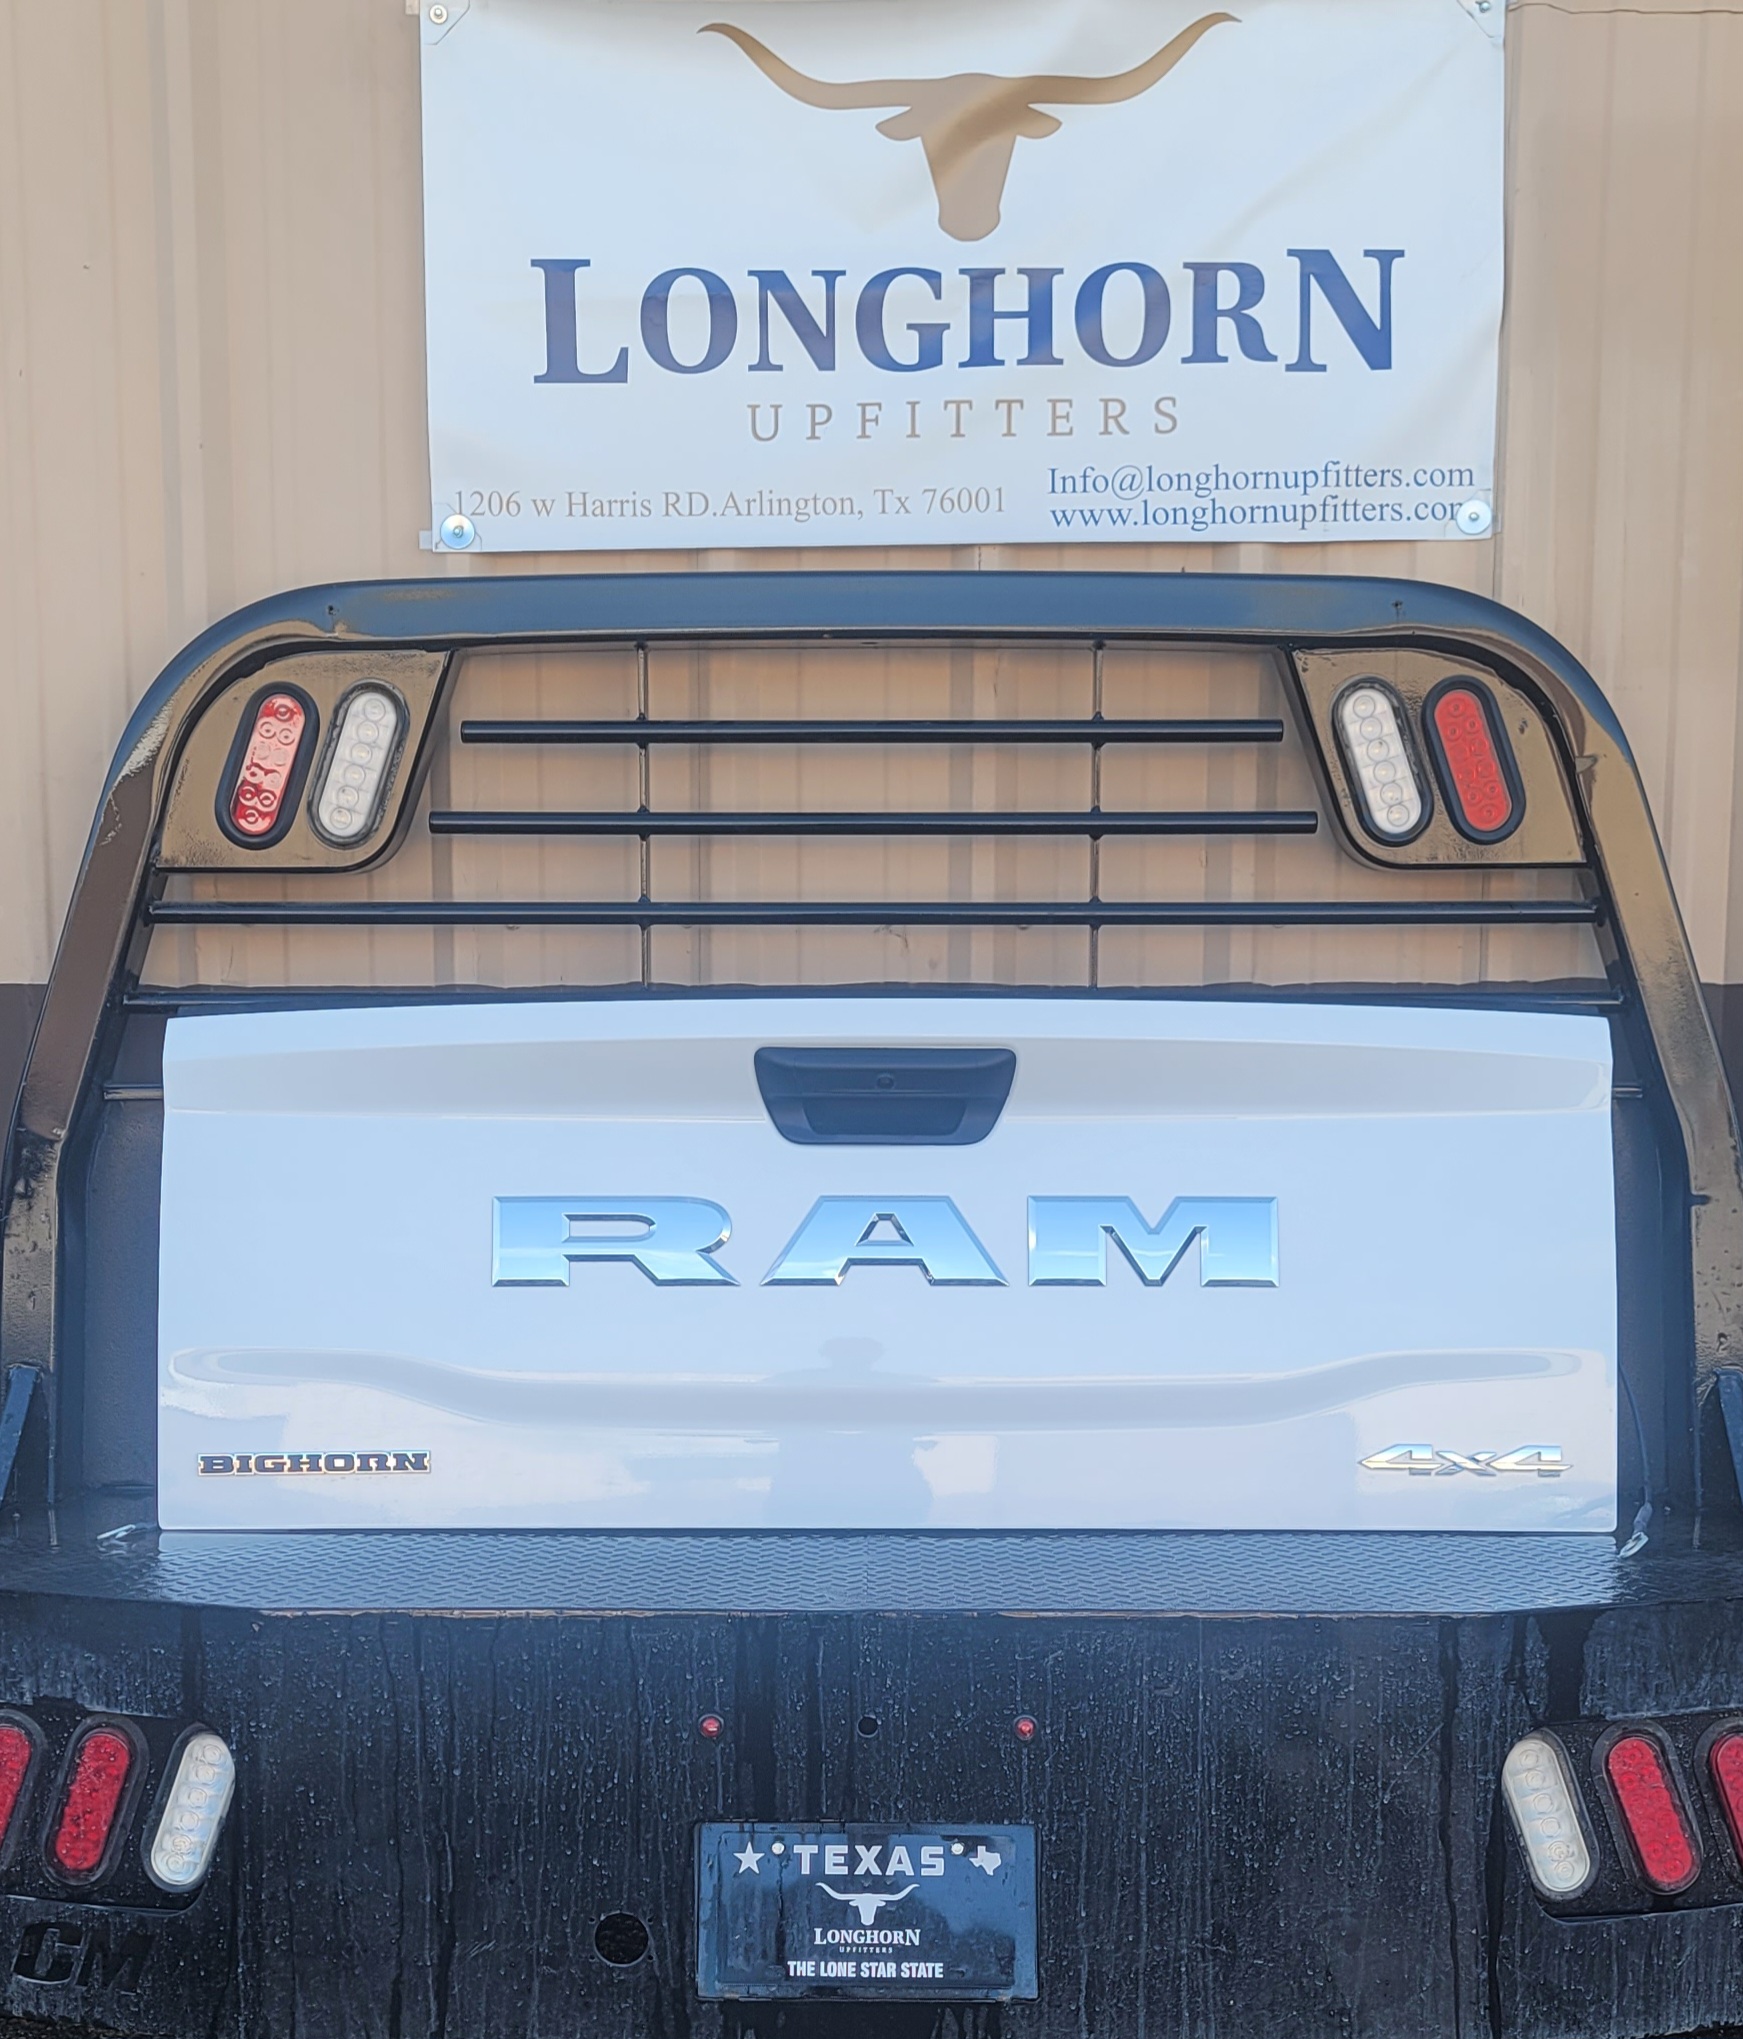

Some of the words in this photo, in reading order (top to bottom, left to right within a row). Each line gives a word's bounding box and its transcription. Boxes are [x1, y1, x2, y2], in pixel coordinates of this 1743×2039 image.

[531, 248, 1405, 385] LONGHORN
[746, 396, 1182, 443] UPFITTERS
[1047, 459, 1475, 501] Info@longhornupfitters.com
[455, 490, 521, 518] 1206
[531, 498, 556, 518] w
[565, 490, 653, 519] Harris
[661, 487, 865, 523] RD.Arlington,
[873, 488, 912, 515] Tx
[921, 486, 1006, 516] 76001
[491, 1195, 1281, 1288] RAM
[198, 1450, 431, 1475] BIGHORN
[1358, 1443, 1574, 1478] 4x4
[794, 1845, 944, 1876] TEXAS
[813, 1928, 921, 1946] LONGHORN
[787, 1960, 816, 1978] THE
[819, 1960, 857, 1979] LONE
[860, 1961, 897, 1978] STAR
[900, 1962, 944, 1979] STATE
